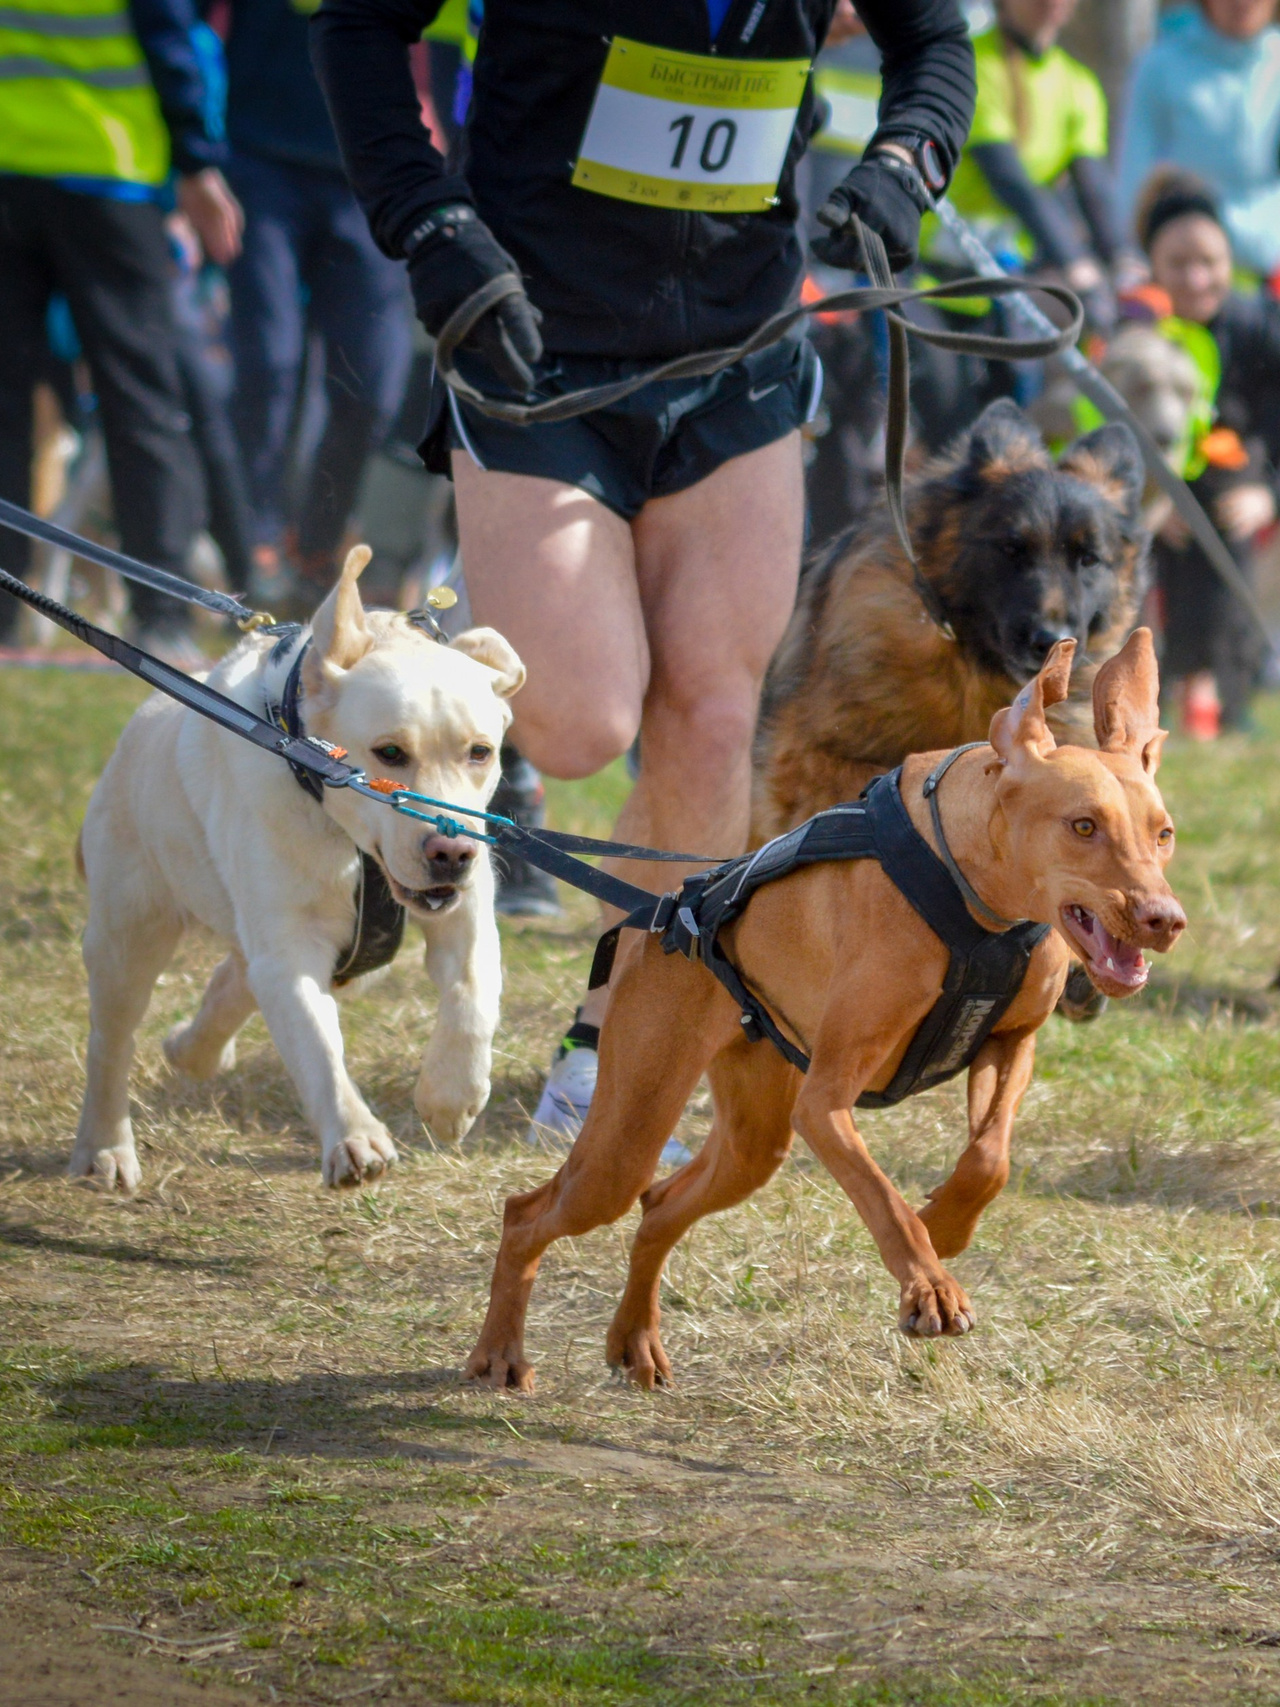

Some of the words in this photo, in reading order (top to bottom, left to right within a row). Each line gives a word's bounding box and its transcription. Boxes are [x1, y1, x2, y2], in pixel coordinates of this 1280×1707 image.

[649, 62, 742, 92] БЫСТРЫЙ
[669, 113, 738, 173] 10
[628, 181, 638, 194] 2
